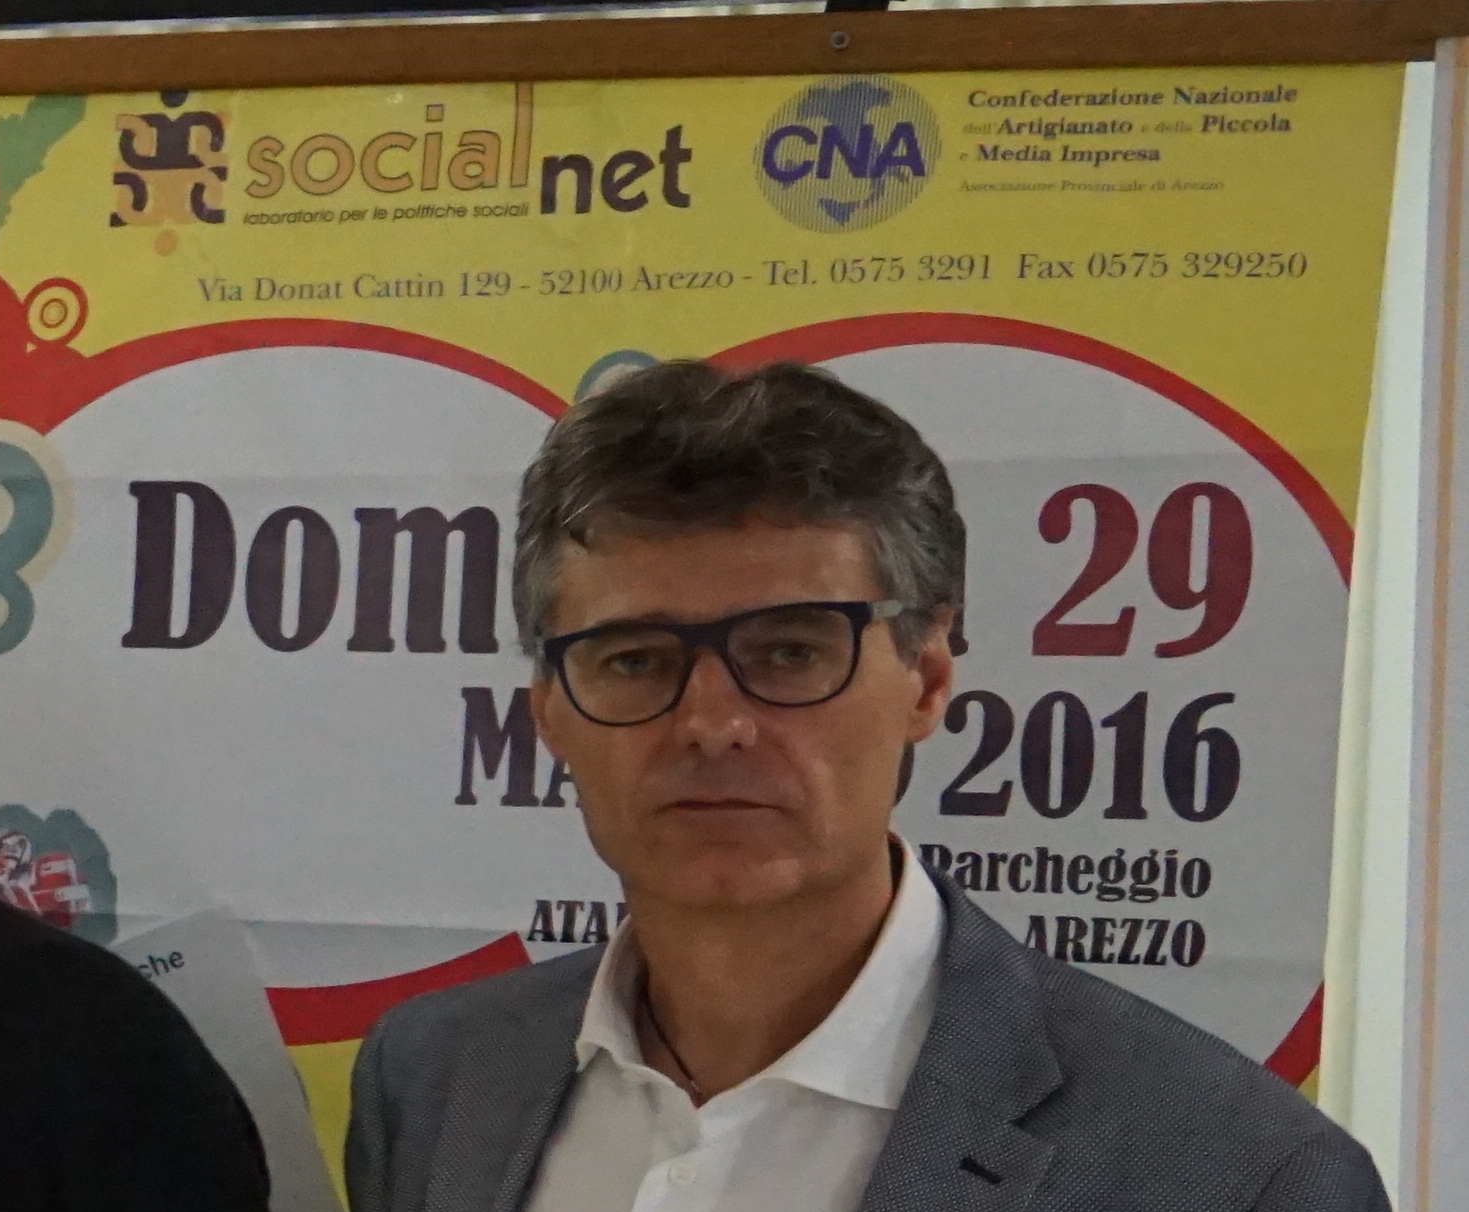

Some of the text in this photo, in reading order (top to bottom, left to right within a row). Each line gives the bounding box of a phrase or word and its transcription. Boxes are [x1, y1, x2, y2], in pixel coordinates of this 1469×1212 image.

[967, 84, 1298, 109] Confederazione Nazionale
[997, 115, 1133, 139] Artigianato
[1200, 112, 1292, 134] Piccola
[761, 120, 927, 184] CNA
[975, 143, 1052, 163] Media
[1060, 144, 1160, 167] Impresa
[243, 202, 530, 226] laboratorio per le politiche sociali
[198, 250, 1309, 302] Via Donat Cattin 129 52100 Arezzo Tel. 0575 3291 Fax 0575 329250
[1030, 480, 1254, 660] 29
[939, 690, 1241, 823] 2016
